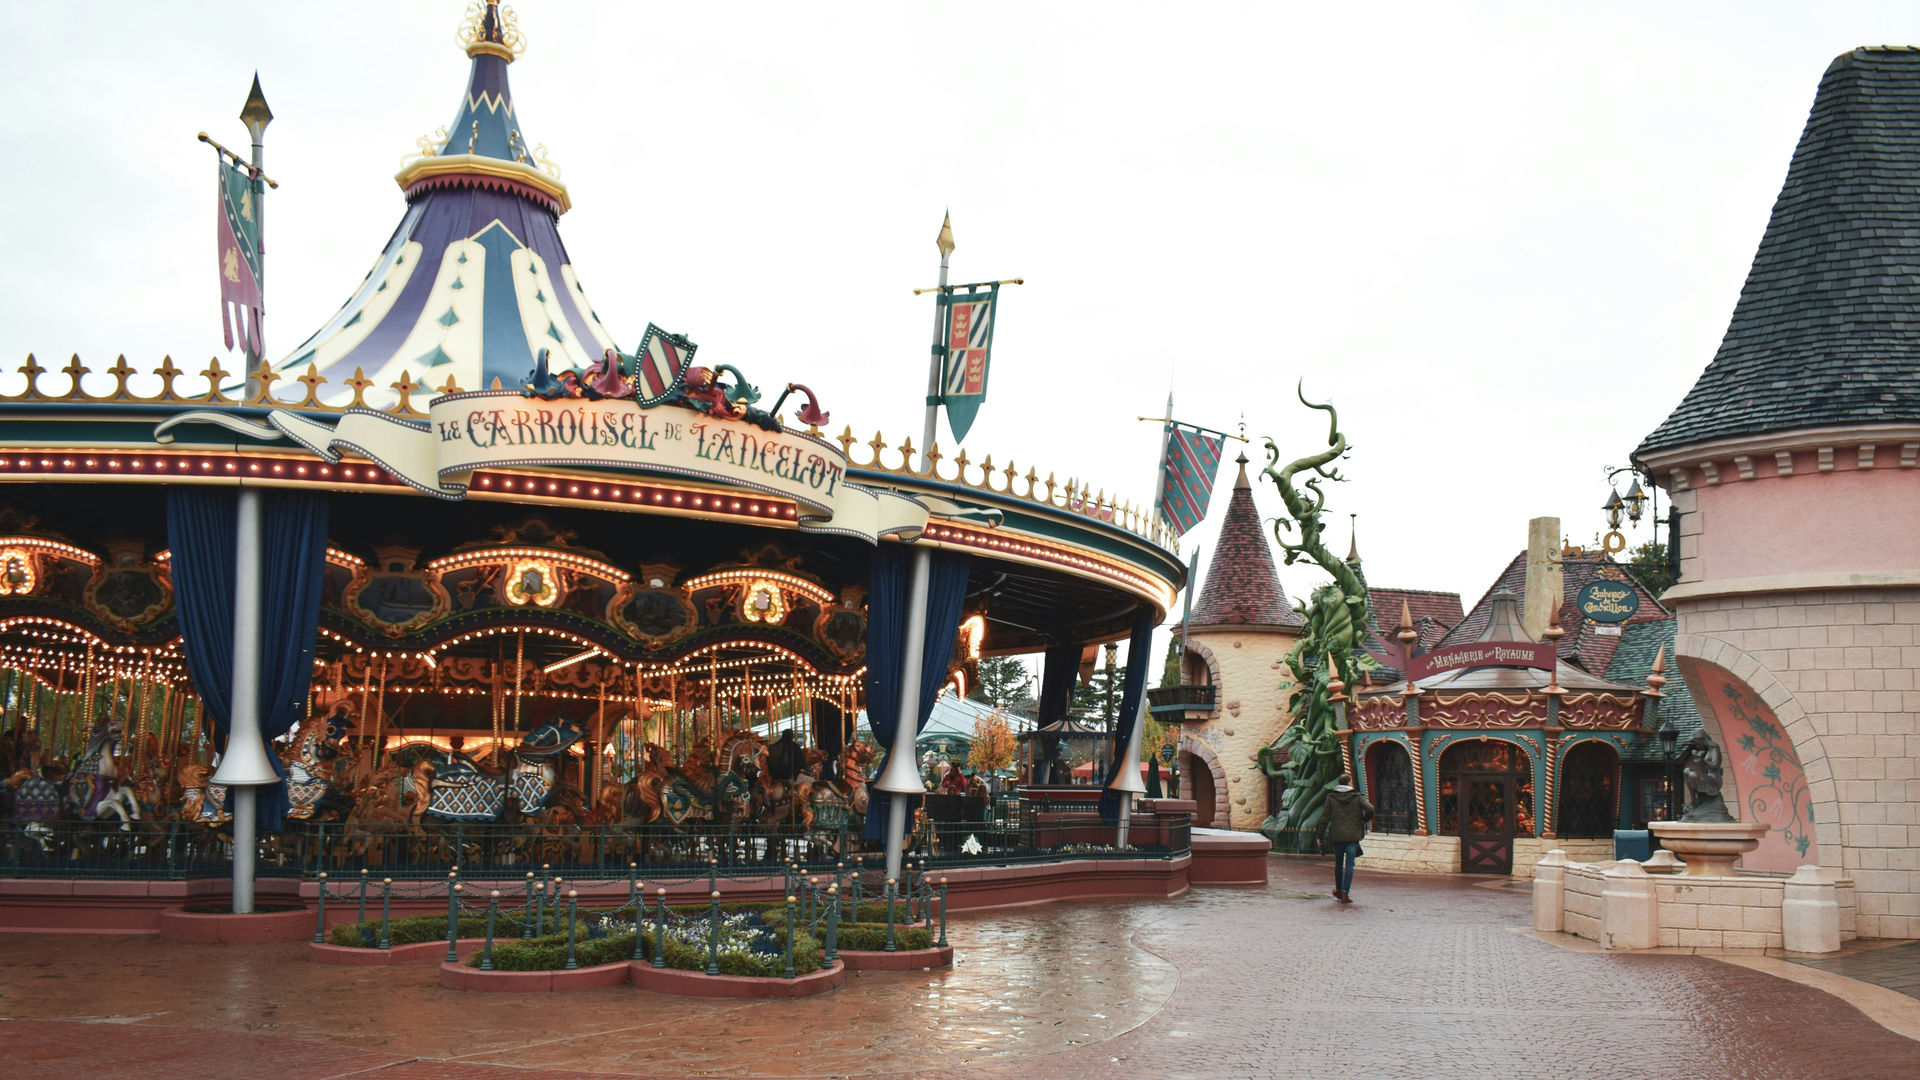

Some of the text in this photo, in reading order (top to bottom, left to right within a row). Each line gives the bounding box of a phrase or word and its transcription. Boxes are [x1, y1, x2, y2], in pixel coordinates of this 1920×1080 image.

[438, 407, 842, 498] LE CARROUSEL DE LANCELOT
[1495, 646, 1535, 661] ROYAUME
